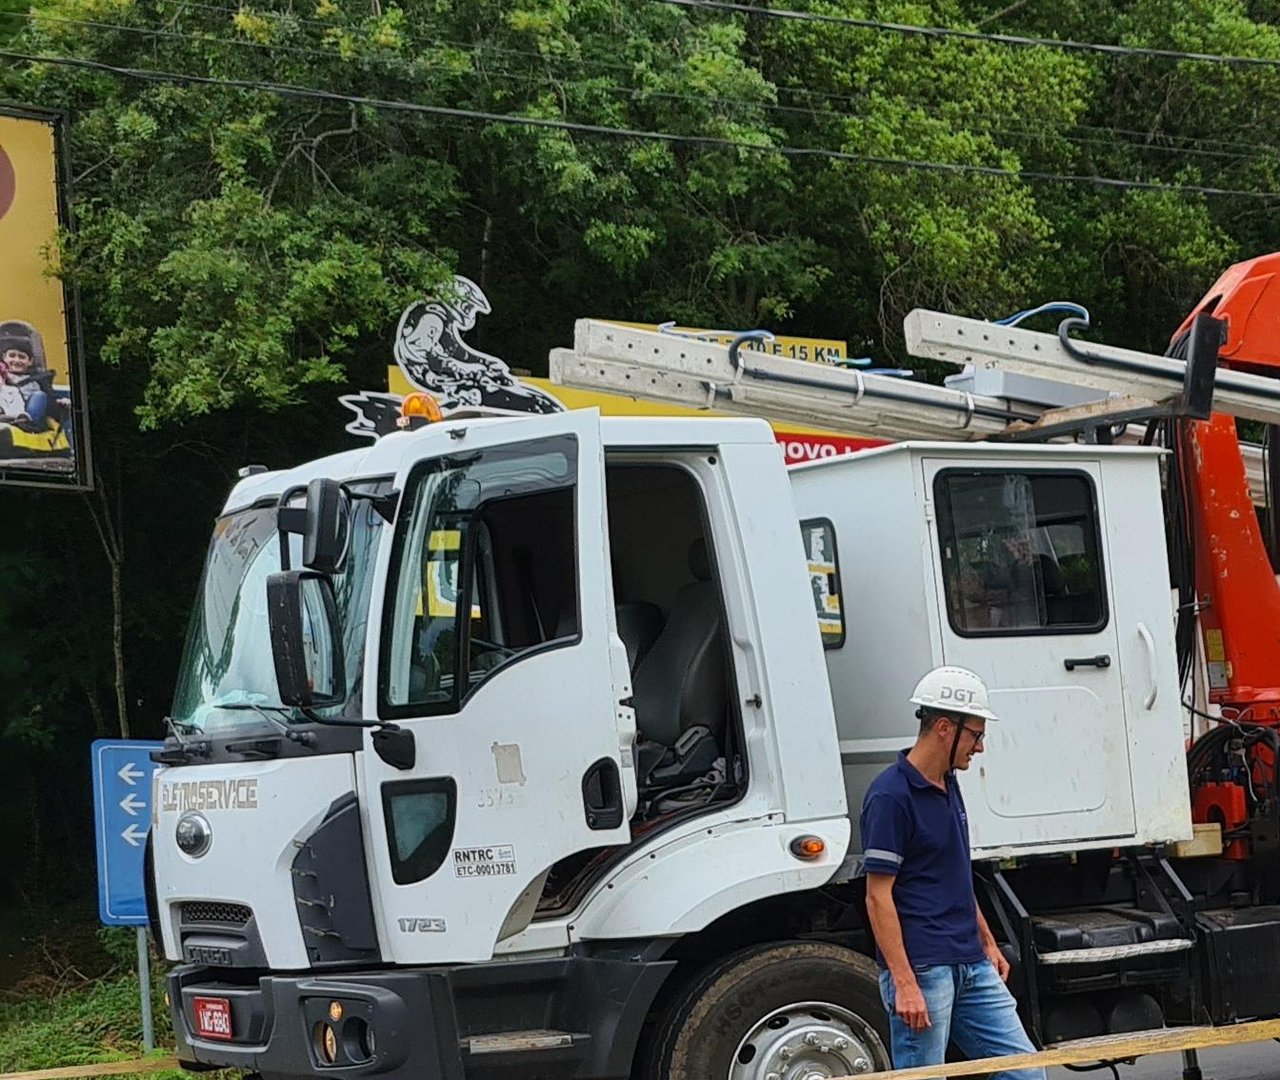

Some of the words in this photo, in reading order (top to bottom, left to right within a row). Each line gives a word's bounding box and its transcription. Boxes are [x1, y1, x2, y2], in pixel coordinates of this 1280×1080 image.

[789, 345, 808, 361] 15
[941, 687, 976, 703] DGT
[454, 849, 494, 863] RNTRC
[397, 918, 446, 932] 1723
